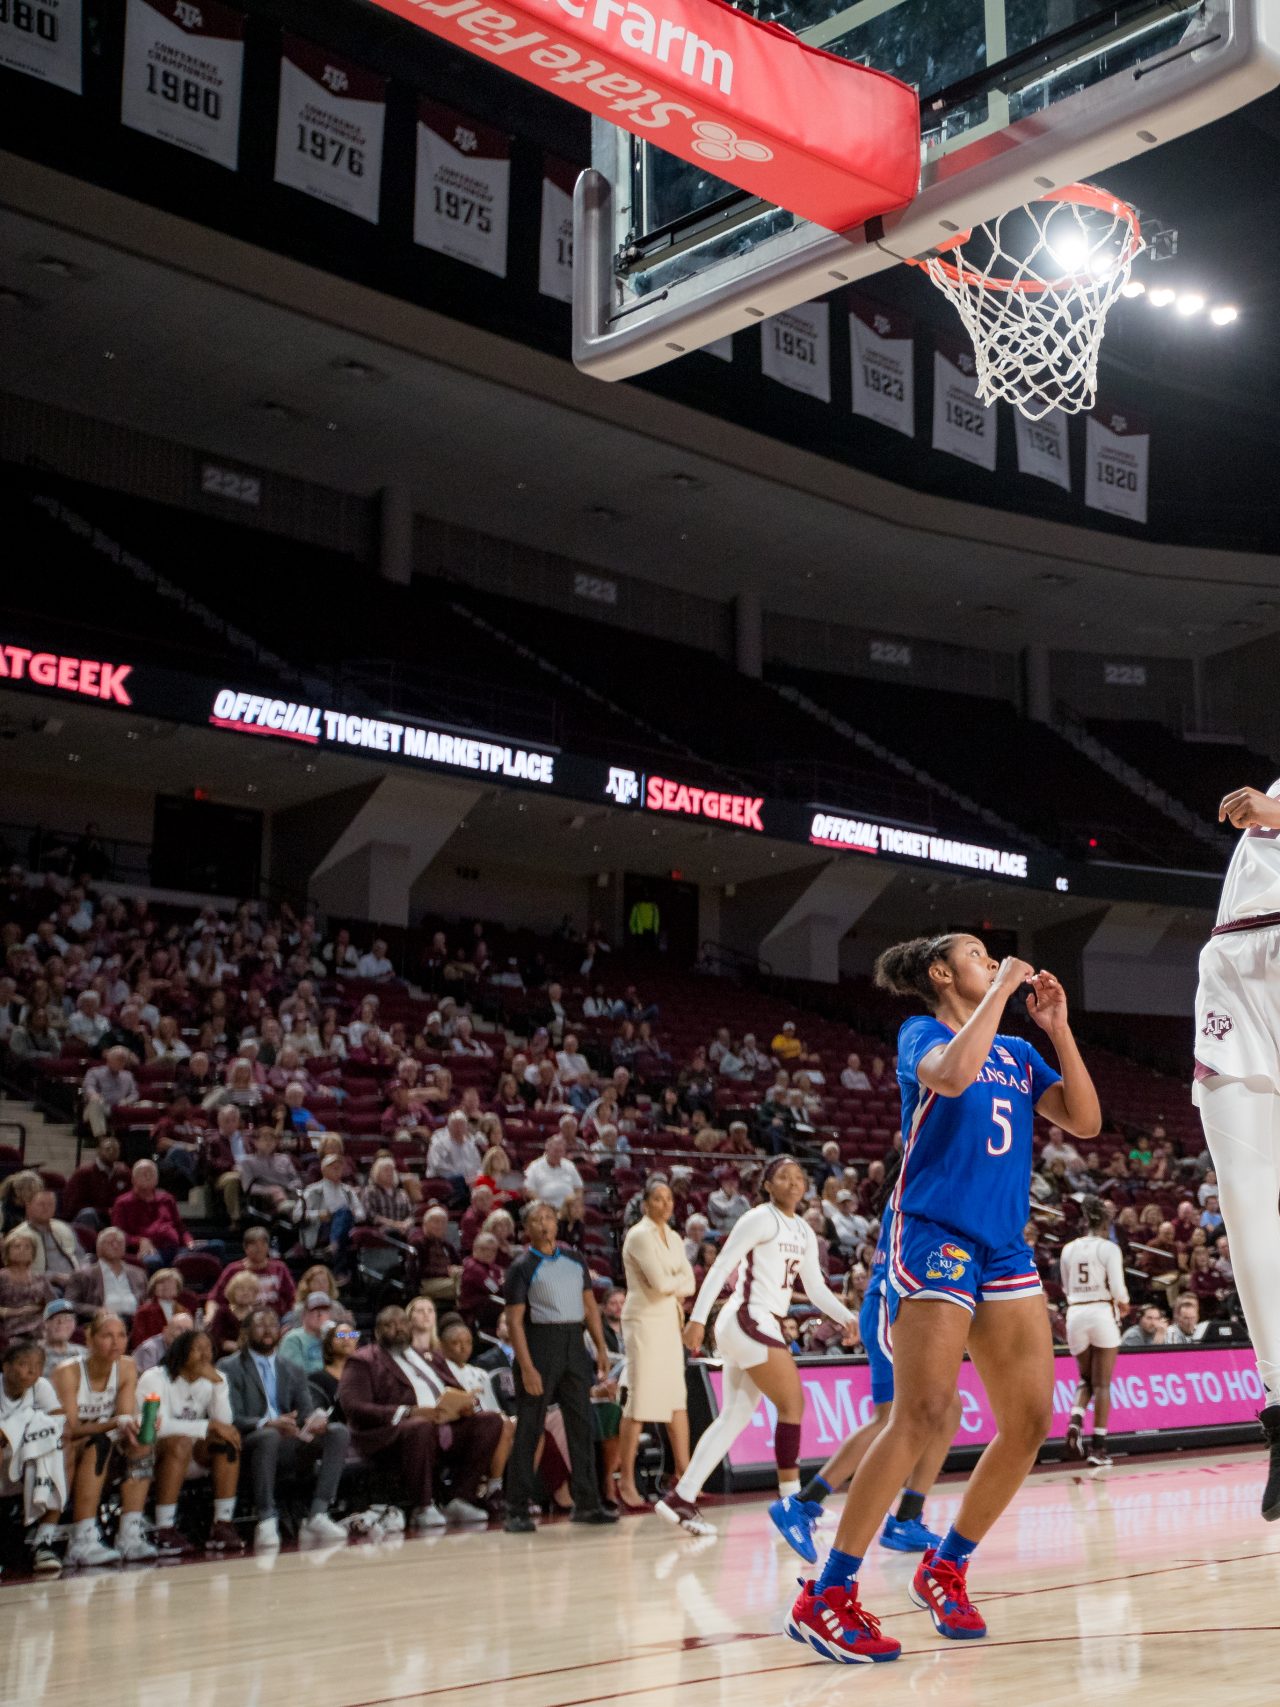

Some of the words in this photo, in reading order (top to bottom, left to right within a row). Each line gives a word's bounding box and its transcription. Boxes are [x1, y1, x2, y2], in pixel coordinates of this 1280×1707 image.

[148, 49, 224, 87] CHAMPIONSHIP
[154, 41, 218, 74] CONFERENCE
[146, 63, 221, 120] 1980
[297, 124, 364, 178] 1976
[432, 186, 493, 234] 1975
[774, 326, 818, 367] 1951
[946, 402, 985, 437] 1922
[1097, 461, 1138, 492] 1920
[212, 689, 322, 738] OFFICIAL
[323, 711, 403, 754] TICKET
[404, 729, 554, 784] MARKETPLACE
[646, 775, 765, 831] SEATGEEK
[811, 813, 879, 849] OFFICIAL
[879, 826, 930, 858] TICKET
[929, 837, 1028, 878] MARKETPLACE
[975, 1065, 1029, 1094] ANSAS
[986, 1097, 1012, 1156] 5
[1078, 1262, 1089, 1284] 5
[1149, 1373, 1192, 1407] 5G
[1185, 1370, 1223, 1403] TO
